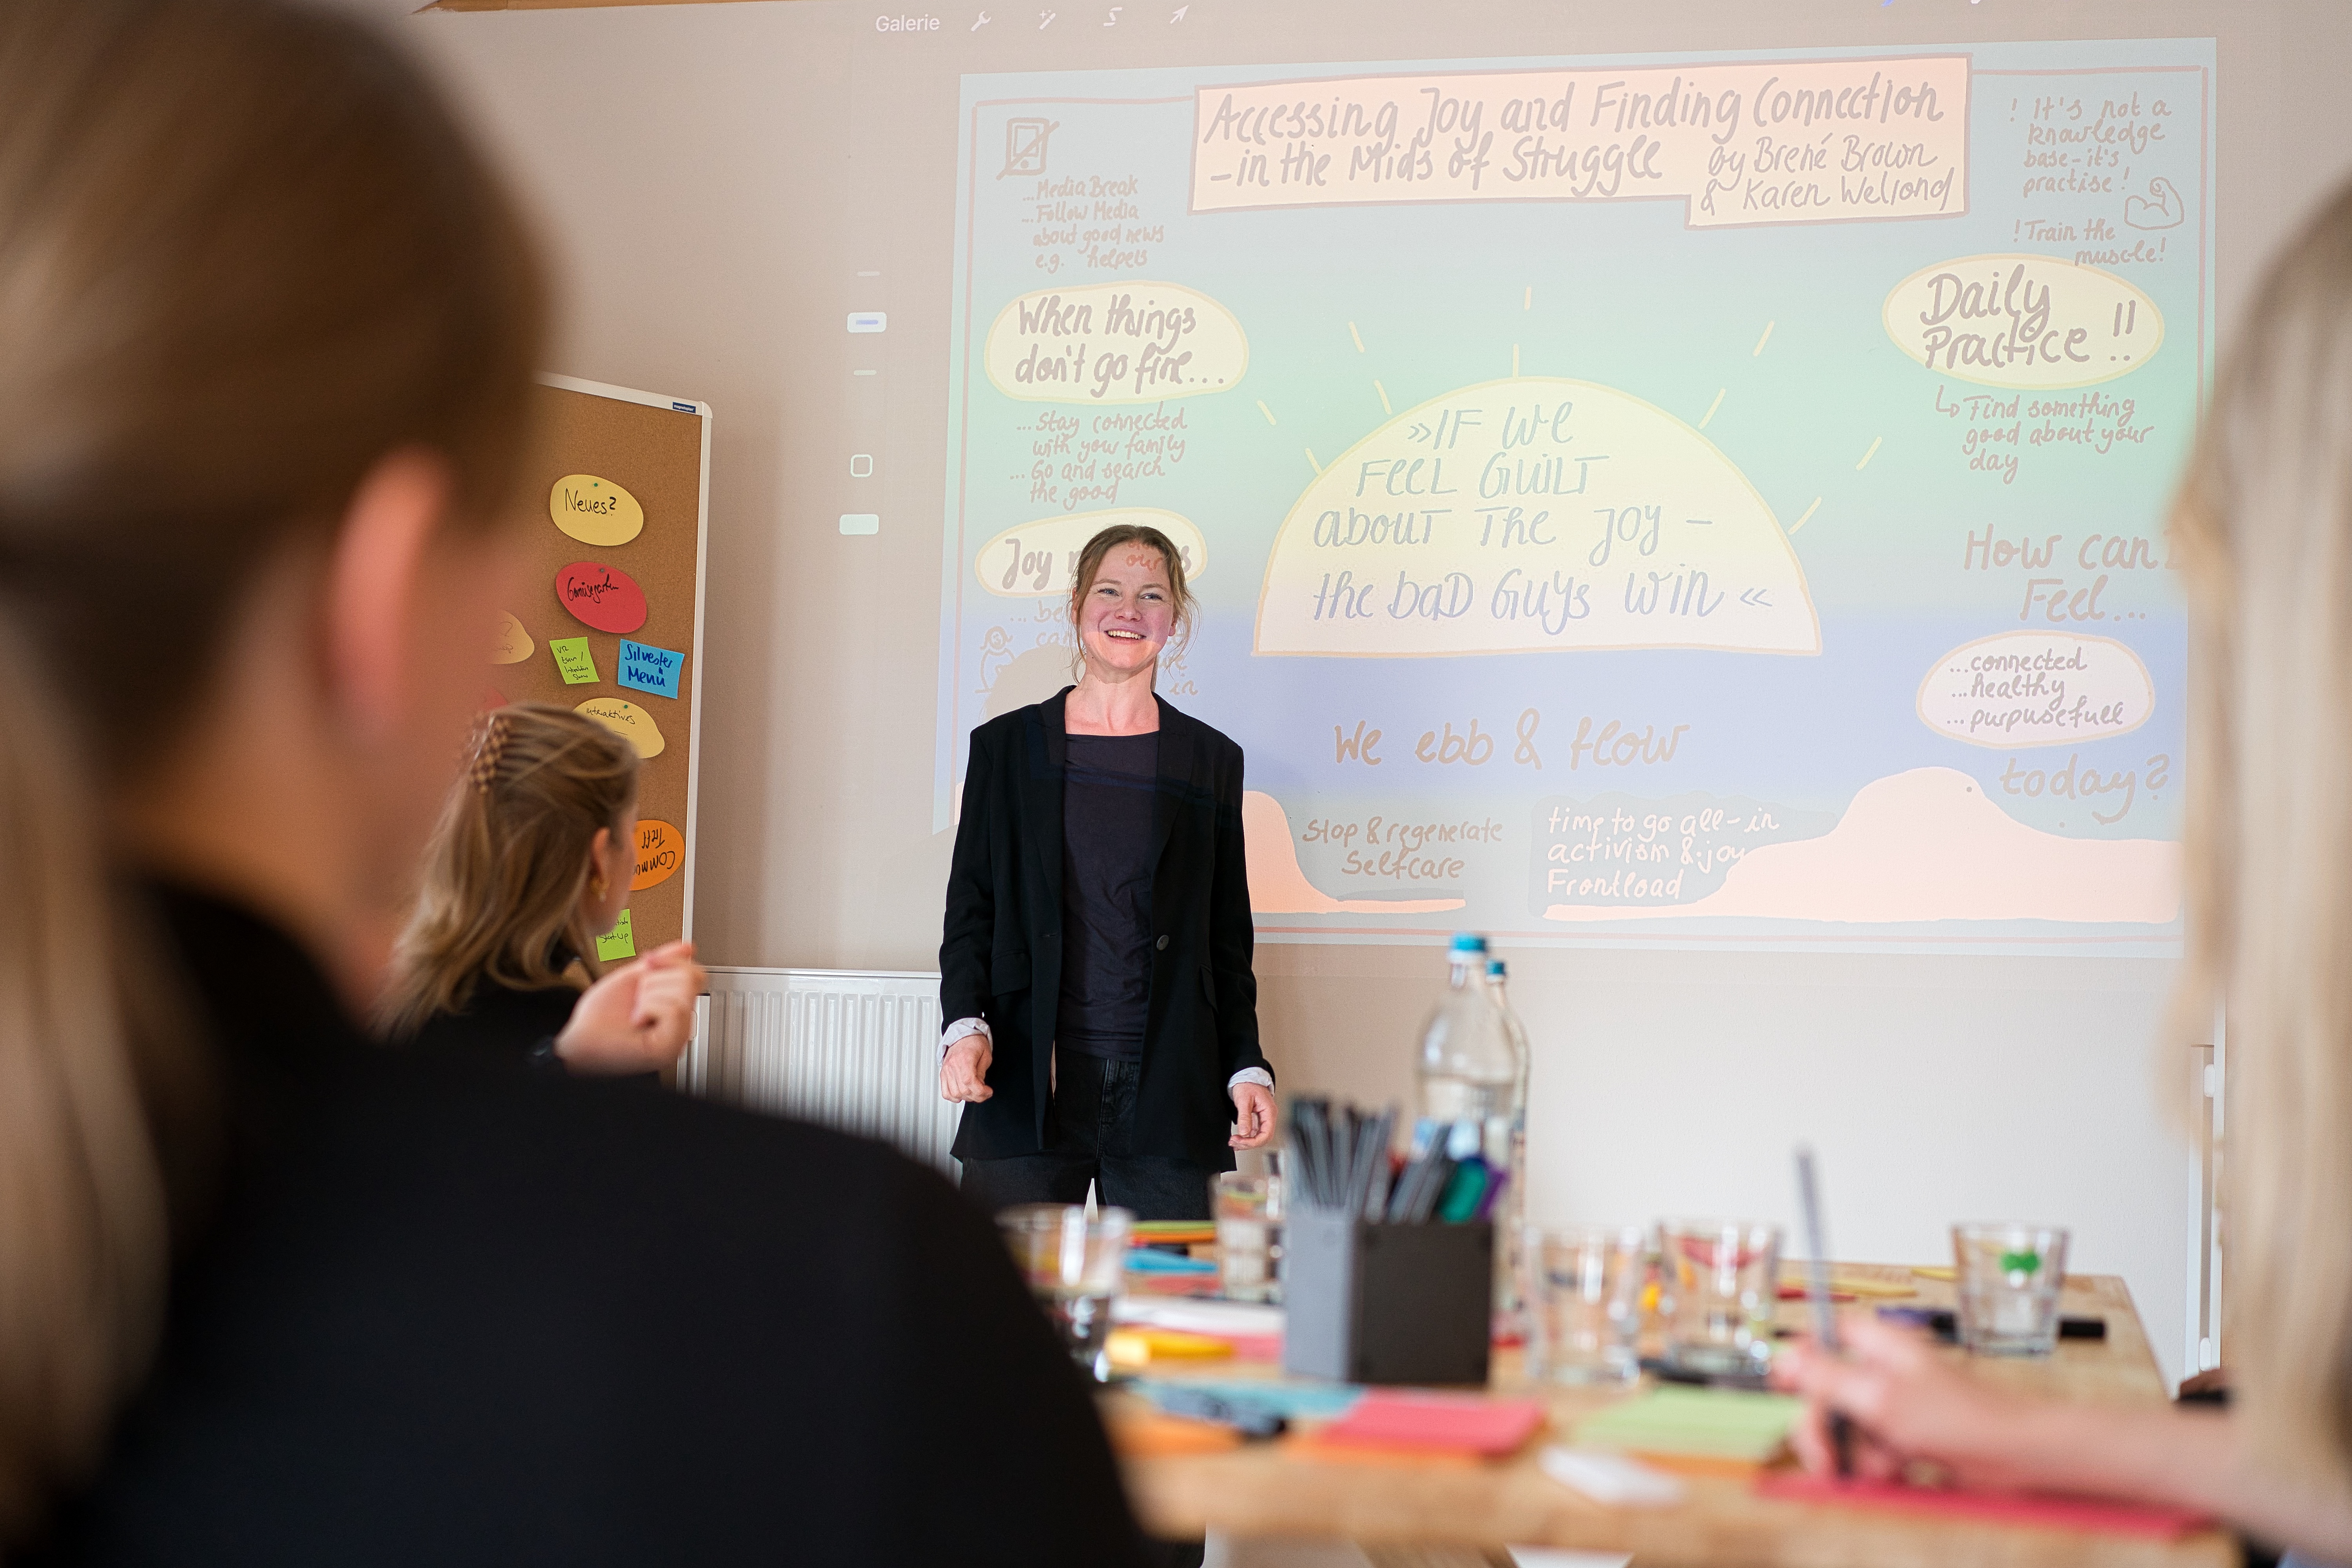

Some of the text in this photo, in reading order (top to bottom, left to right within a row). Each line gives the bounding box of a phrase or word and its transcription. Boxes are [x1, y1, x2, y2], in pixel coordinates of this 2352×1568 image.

[875, 13, 940, 32] Galerie
[1203, 71, 1944, 156] Accessing Joy and Finding Connection
[2034, 96, 2083, 121] It's
[2101, 91, 2141, 118] not
[2152, 99, 2172, 116] a
[2027, 118, 2166, 154] knowledge
[1280, 140, 1332, 186] the
[1448, 131, 1494, 190] of
[1503, 134, 1662, 196] Struggle
[1709, 132, 1938, 191] by Brené Brown
[1089, 174, 1138, 198] Break
[1700, 178, 1718, 216] &
[1742, 178, 1831, 210] Karen
[1093, 198, 1140, 220] Media
[1033, 223, 1164, 254] about good news
[2083, 218, 2116, 241] the
[1035, 253, 1065, 274] e.g.
[2074, 237, 2167, 266] muscle!
[1920, 263, 2051, 343] Daily
[1019, 294, 1196, 355] When things
[1922, 313, 2090, 369] Practice
[1015, 343, 1086, 384] don't
[1089, 352, 1129, 398] go
[1093, 401, 1188, 434] connected
[1962, 392, 2135, 427] Find something
[1032, 434, 1071, 458] with
[1124, 430, 1186, 463] family
[1962, 418, 2154, 455] good about your
[1062, 459, 1096, 481] and
[1969, 450, 2019, 485] day
[565, 487, 617, 517] Neues?
[1030, 476, 1120, 511] the good
[1001, 538, 1053, 591] Joy
[1963, 523, 2062, 571] How
[2078, 534, 2158, 570] can
[556, 646, 570, 654] VR
[624, 643, 673, 668] Silvester
[627, 665, 666, 687] Menü
[1415, 718, 1495, 766] ebb
[1514, 707, 1543, 771] &
[1570, 715, 1691, 771] flow
[1367, 815, 1383, 845] &
[1386, 817, 1503, 852] regenerate
[1548, 806, 1605, 833] time
[1611, 807, 1635, 835] to
[1637, 813, 1673, 843] go
[1547, 828, 1670, 864] activism
[1680, 835, 1694, 865] &
[1341, 849, 1466, 880] Selfcare
[1548, 868, 1684, 900] Frontload
